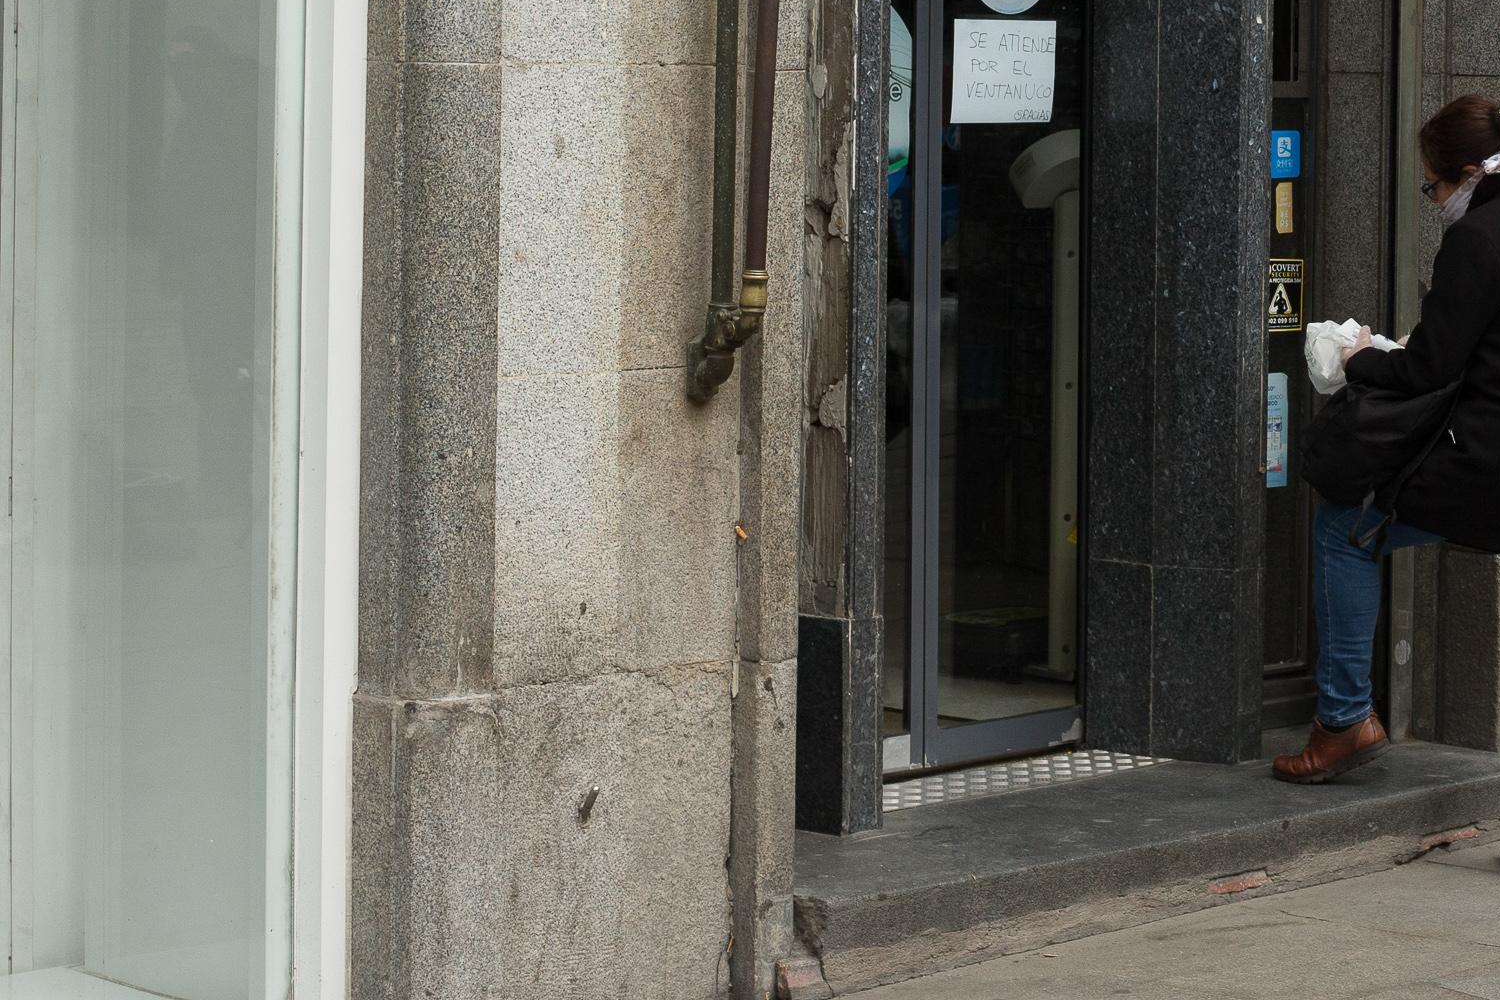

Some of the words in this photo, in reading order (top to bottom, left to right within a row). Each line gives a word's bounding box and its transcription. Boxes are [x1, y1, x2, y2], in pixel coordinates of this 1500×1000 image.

[969, 31, 988, 49] SE
[998, 33, 1056, 53] ATIENDE
[971, 59, 999, 73] POR
[1013, 60, 1032, 77] EL
[966, 81, 1052, 100] VENTANUCO
[1014, 108, 1050, 121] GRACIAS
[1271, 263, 1301, 272] COVERT
